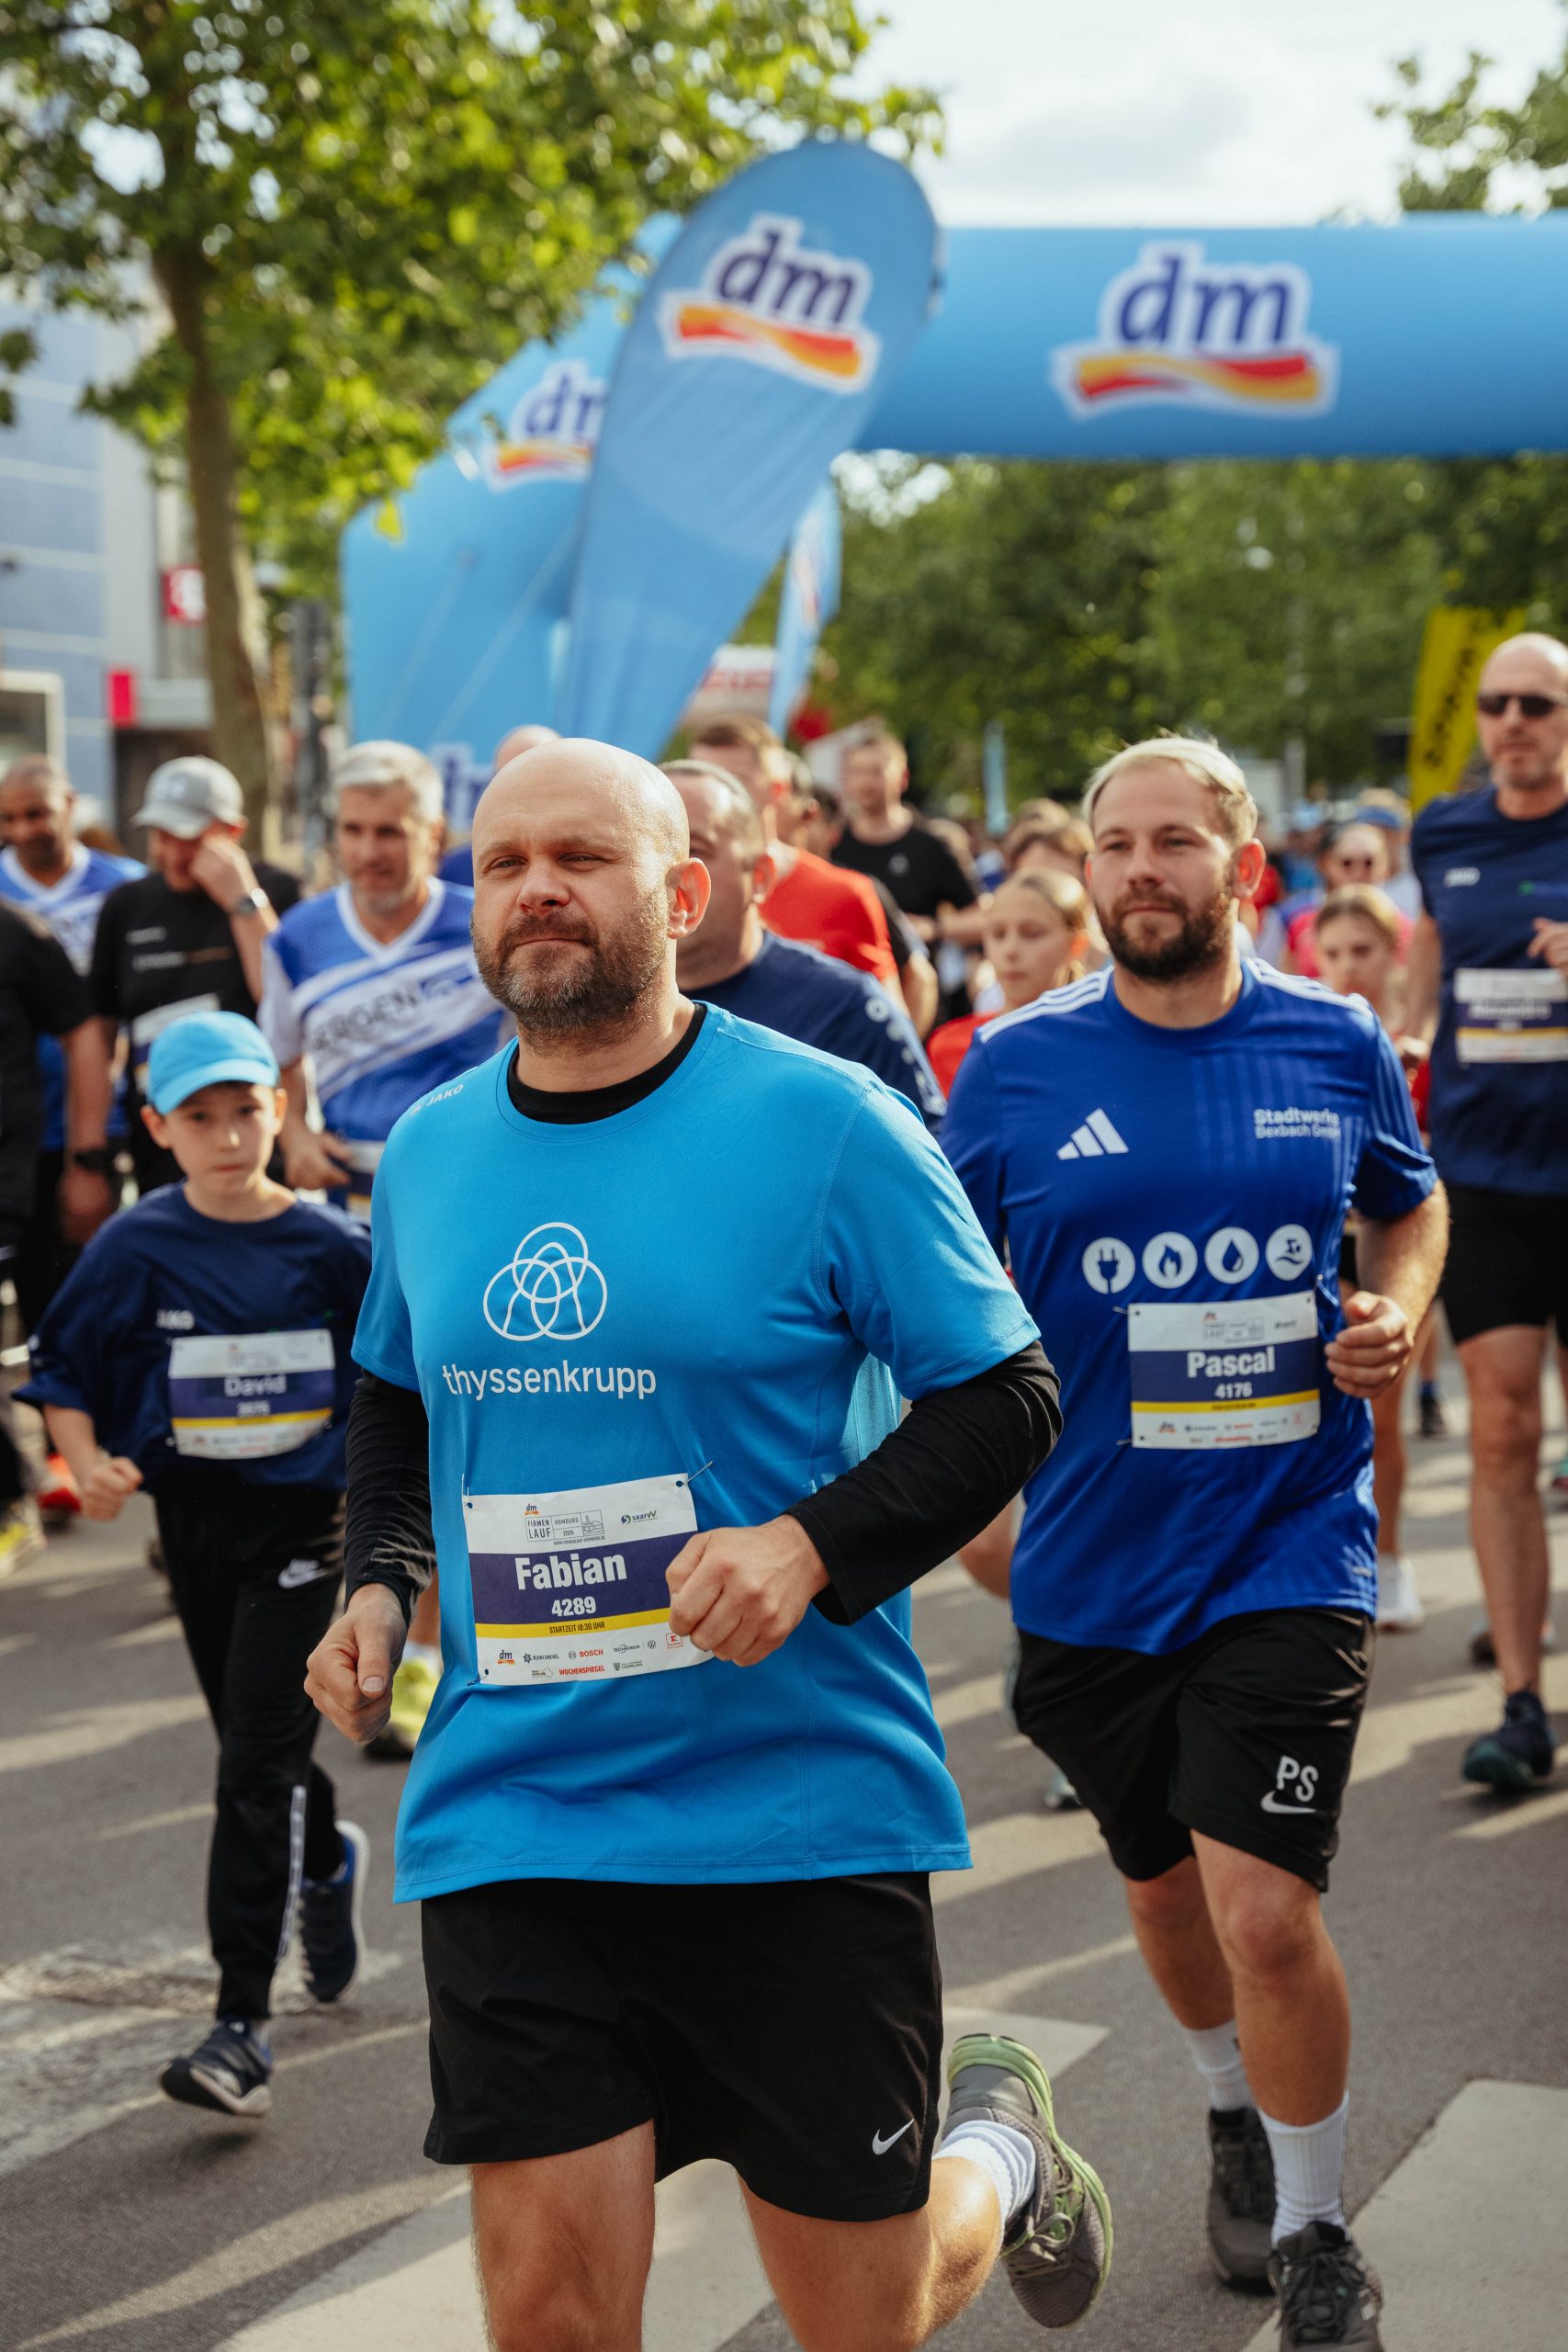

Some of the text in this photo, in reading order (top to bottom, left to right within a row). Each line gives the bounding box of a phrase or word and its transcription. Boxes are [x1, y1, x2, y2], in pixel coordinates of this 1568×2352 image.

[716, 228, 854, 324] dm
[1119, 254, 1289, 344] dm
[426, 1084, 464, 1106] JAKO
[1187, 1345, 1276, 1377] Pascal
[224, 1374, 287, 1396] David
[442, 1359, 657, 1401] thyssenkrupp
[527, 1520, 550, 1528] FIRMEN
[555, 1517, 579, 1525] HOMBURG
[528, 1527, 551, 1539] LAUF
[514, 1553, 627, 1590] Fabian
[551, 1596, 596, 1617] 4289
[549, 1624, 576, 1634] STARTZEIT
[592, 1622, 605, 1630] UHR
[499, 1649, 513, 1659] dm
[533, 1653, 559, 1661] KARLSBERG
[579, 1649, 604, 1657] BOSCH
[558, 1665, 605, 1675] WOCHENSPIEGEL
[1276, 1755, 1319, 1803] PS
